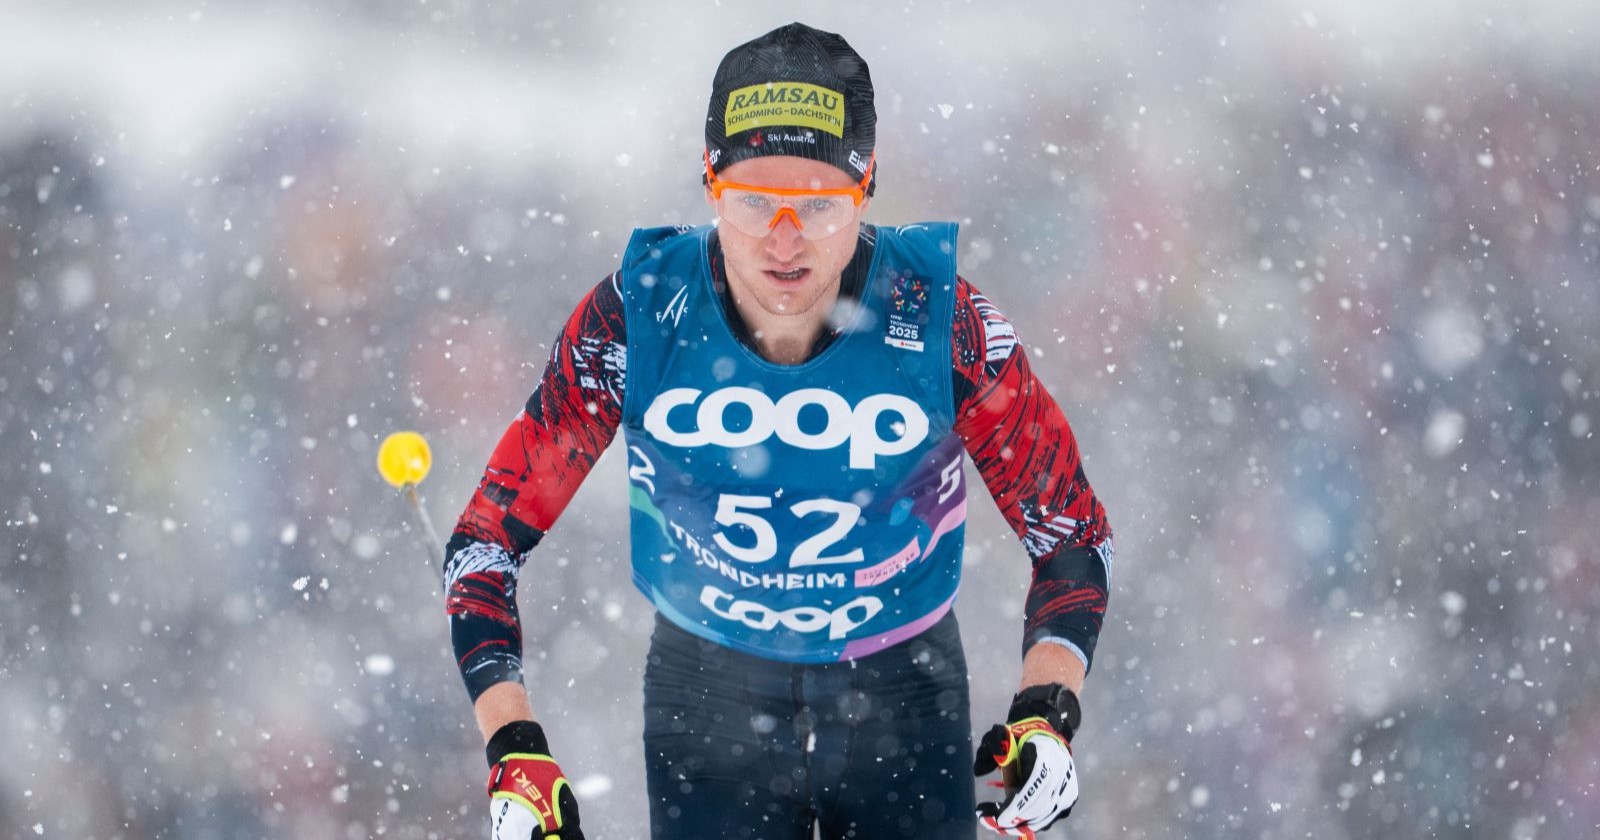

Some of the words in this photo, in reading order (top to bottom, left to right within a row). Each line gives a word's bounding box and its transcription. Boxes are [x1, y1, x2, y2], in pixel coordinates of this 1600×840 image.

[730, 88, 839, 112] RAMSAU
[767, 133, 781, 142] Ski
[784, 133, 815, 144] Austria
[889, 326, 918, 339] 2025
[890, 320, 919, 330] TRONDHEIM
[643, 386, 930, 470] coop
[669, 519, 846, 590] TRONDHEIM
[712, 493, 865, 569] 52
[699, 584, 884, 641] coop
[510, 767, 553, 818] LEKI
[1016, 761, 1049, 811] ziener
